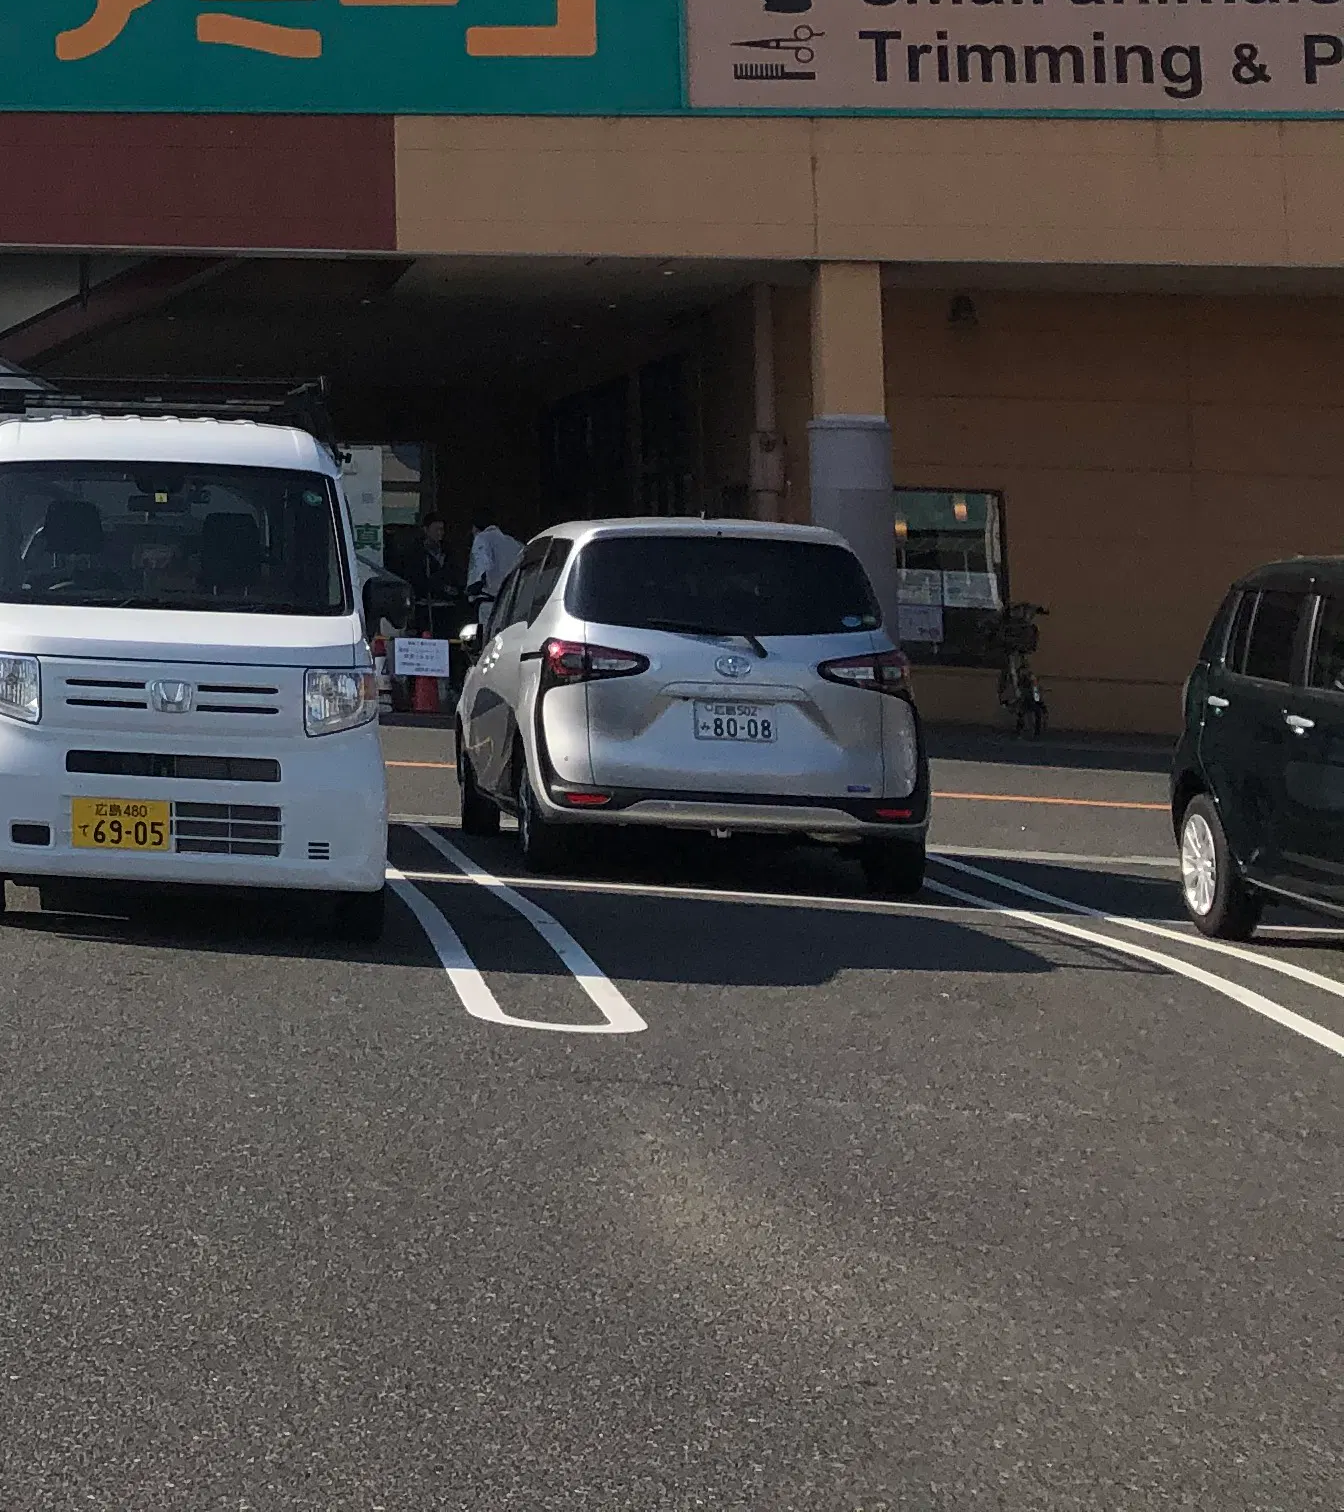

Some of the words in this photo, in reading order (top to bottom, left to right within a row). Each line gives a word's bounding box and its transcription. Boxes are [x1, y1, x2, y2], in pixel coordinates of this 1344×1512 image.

[858, 29, 1204, 99] Trimming
[1231, 42, 1272, 85] &
[713, 717, 772, 738] 80-08
[95, 803, 148, 817] 広島480
[93, 819, 165, 846] 69-05
